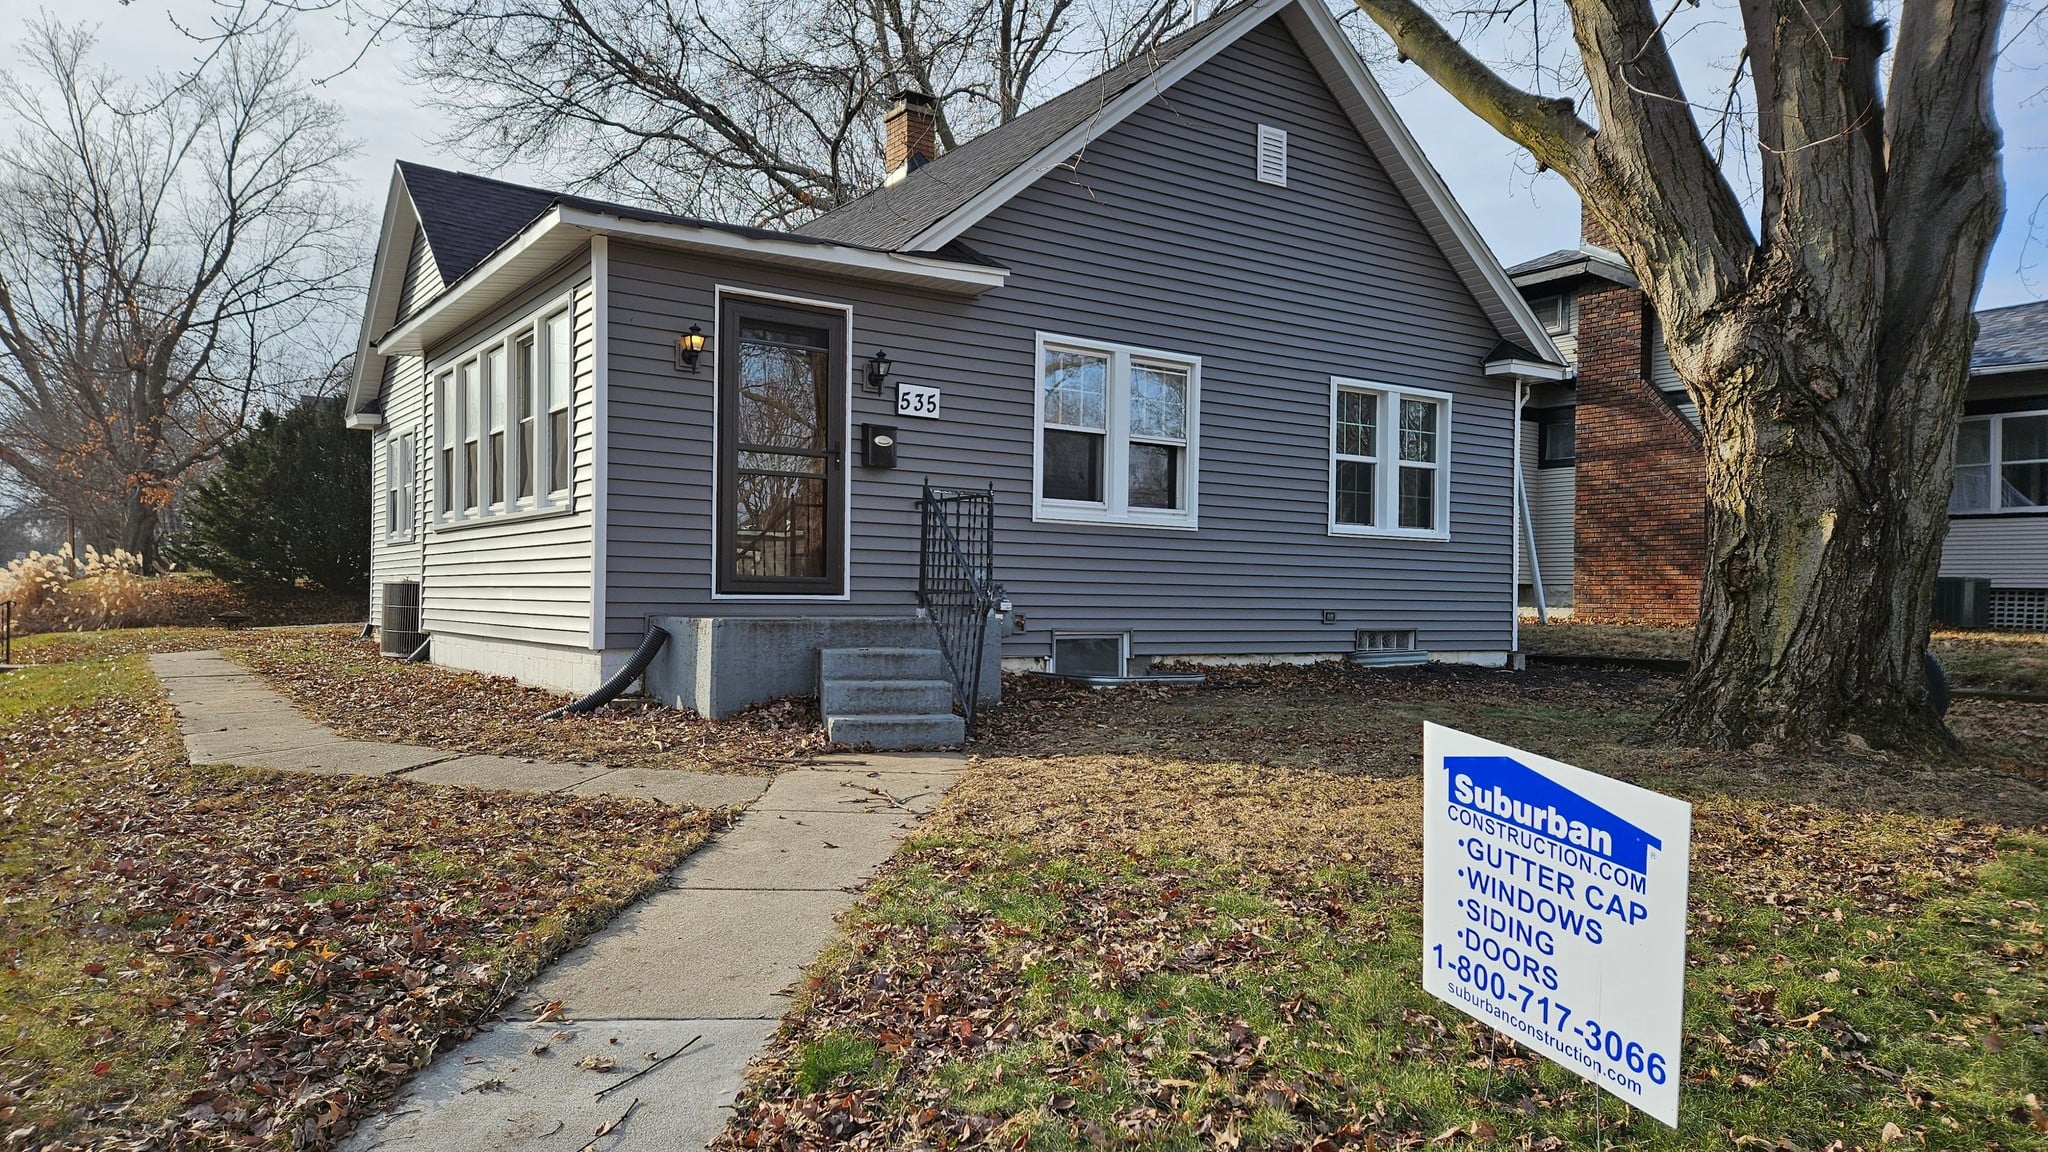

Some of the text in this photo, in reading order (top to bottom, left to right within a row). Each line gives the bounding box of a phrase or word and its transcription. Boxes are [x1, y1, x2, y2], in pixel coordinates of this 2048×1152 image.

[900, 391, 937, 413] 535
[1447, 805, 1647, 896] CONSTRUCTION.COM
[1454, 773, 1613, 856] Suburban
[1467, 837, 1648, 926] GUTTER CAP
[1467, 869, 1603, 945] WINDOWS
[1465, 929, 1558, 991] DOORS
[1467, 898, 1555, 956] SIDING
[1432, 943, 1667, 1085] 1-800-717-3066
[1447, 981, 1642, 1096] suburbanconstruction.com
